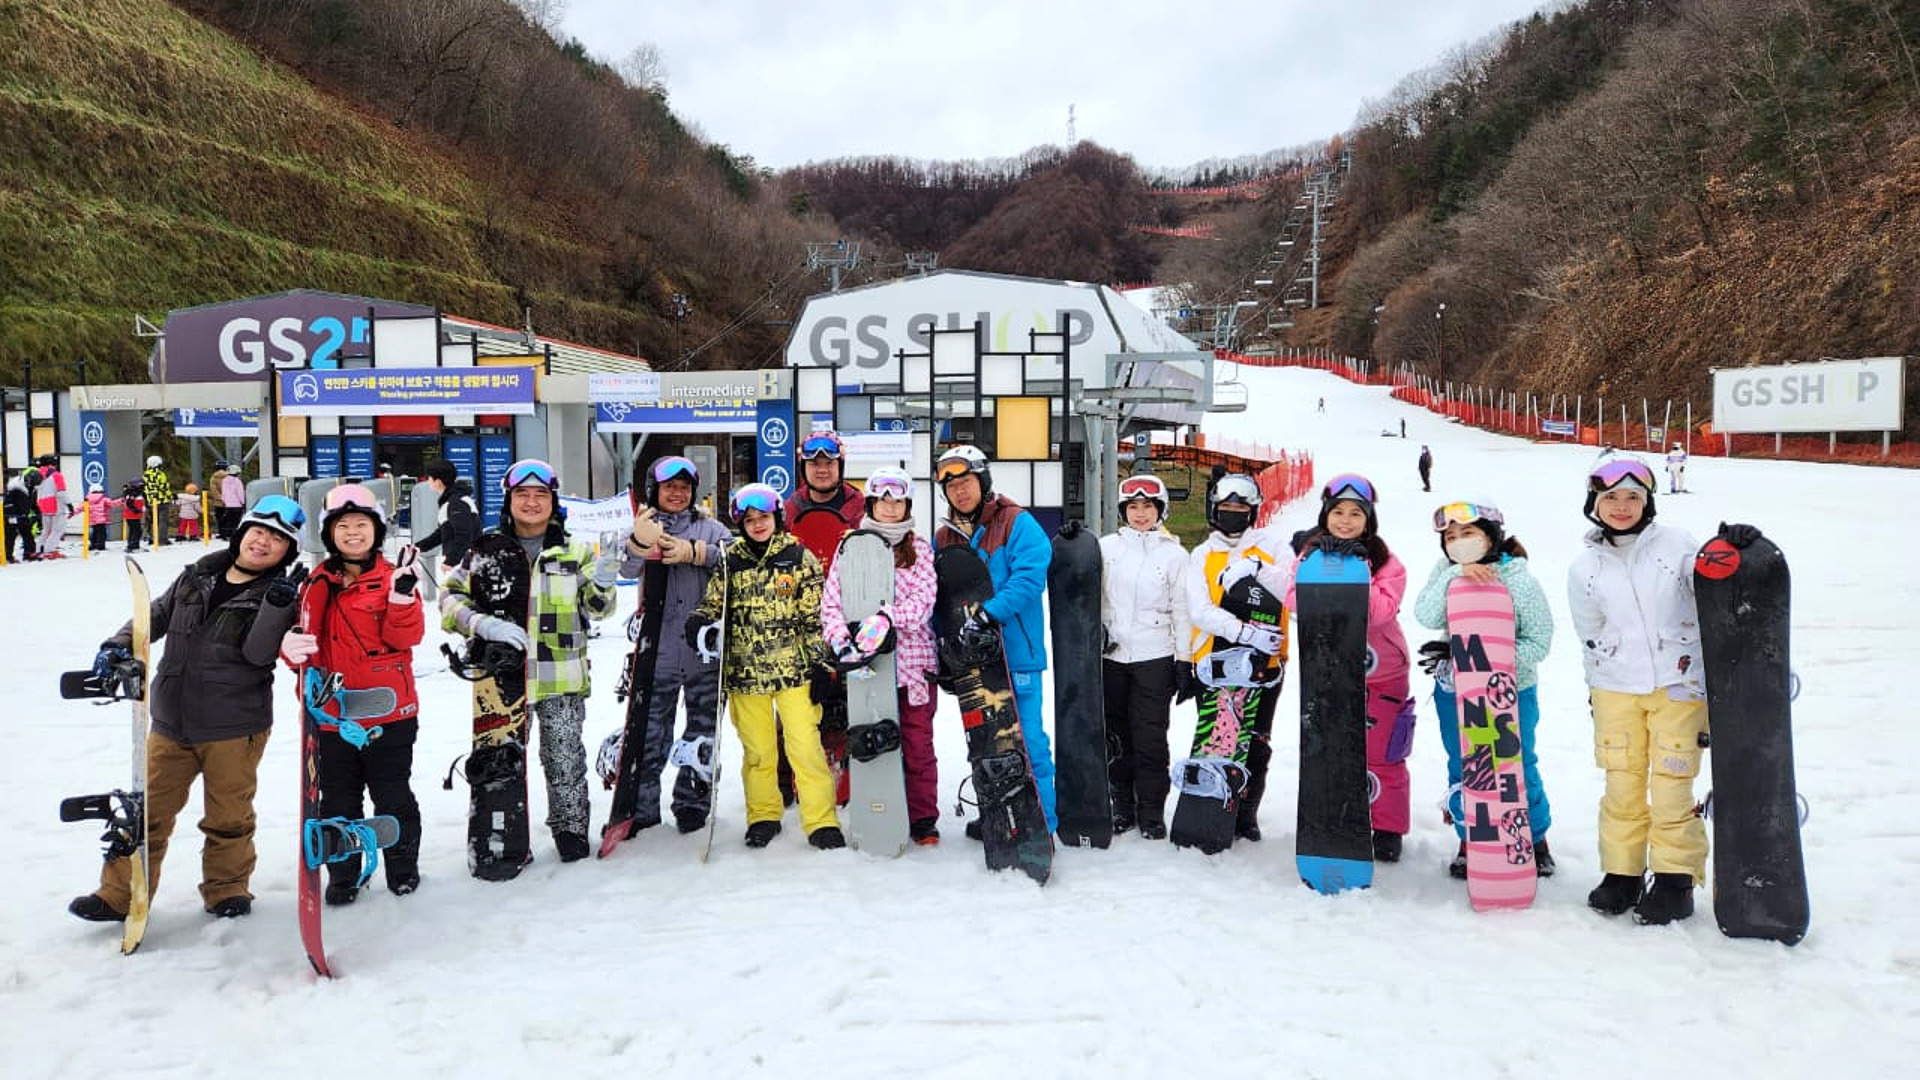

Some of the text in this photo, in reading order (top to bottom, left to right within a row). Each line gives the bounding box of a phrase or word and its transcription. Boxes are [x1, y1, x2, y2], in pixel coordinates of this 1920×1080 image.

[808, 315, 890, 368] GS
[672, 383, 755, 397] intermediate
[1732, 378, 1772, 407] GS
[94, 395, 135, 409] beginner
